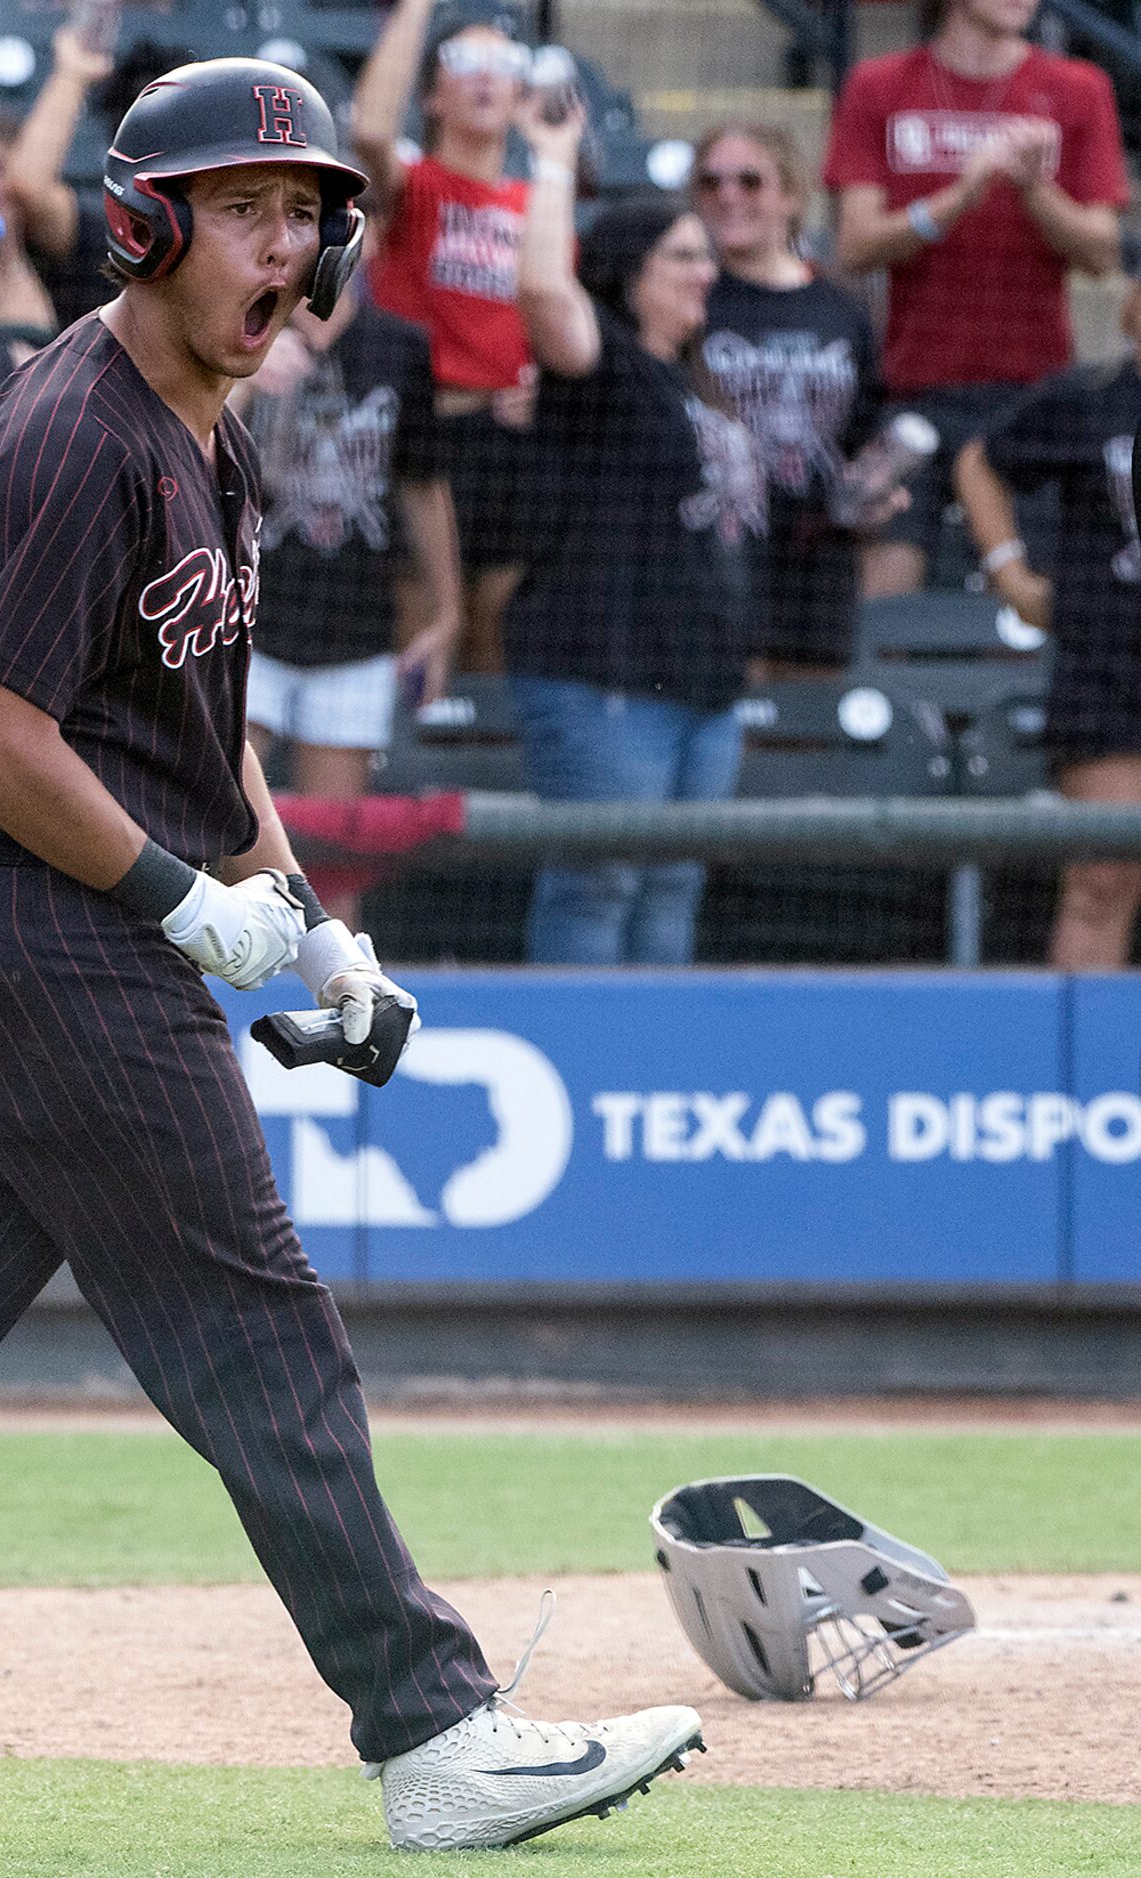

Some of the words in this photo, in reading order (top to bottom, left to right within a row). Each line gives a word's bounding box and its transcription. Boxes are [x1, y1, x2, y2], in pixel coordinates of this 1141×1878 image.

[253, 85, 307, 148] H
[594, 1090, 866, 1163] TEXAS
[887, 1090, 1141, 1164] DISPO
